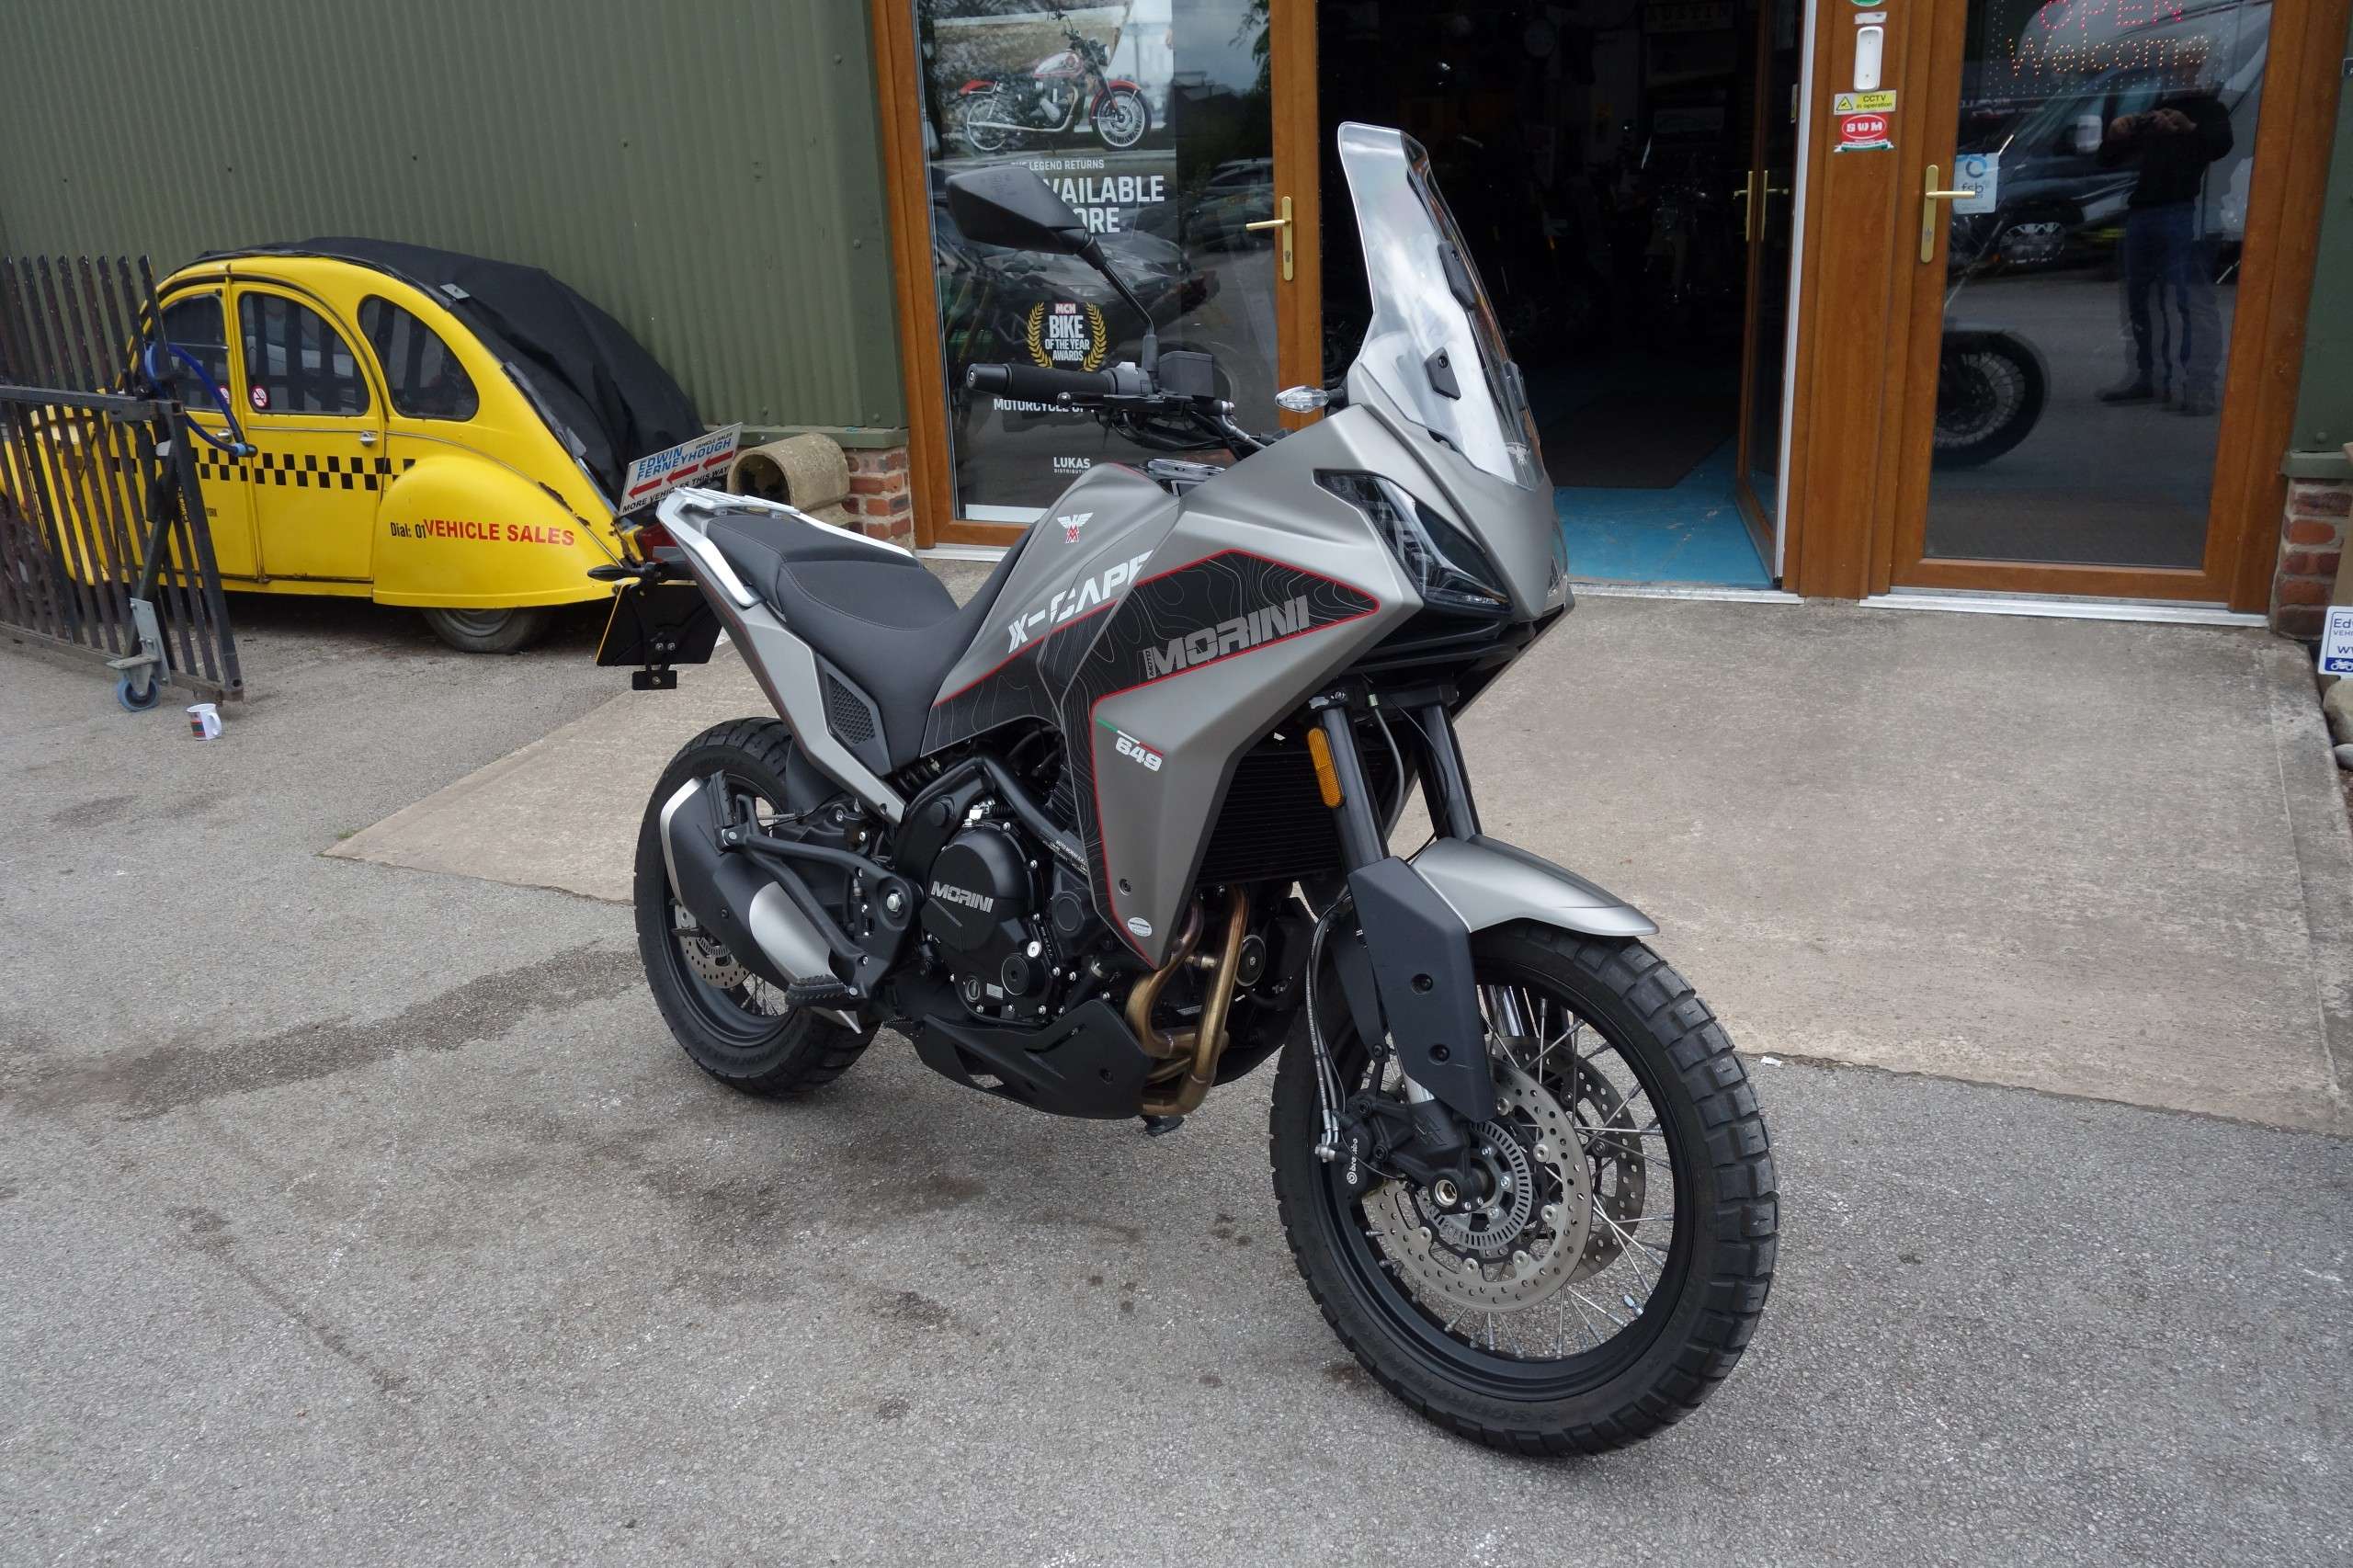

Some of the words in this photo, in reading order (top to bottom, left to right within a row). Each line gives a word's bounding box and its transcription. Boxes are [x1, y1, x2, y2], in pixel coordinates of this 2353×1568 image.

[2039, 0, 2183, 29] OPEN
[1862, 95, 1886, 103] CCTV
[1863, 100, 1893, 109] operation
[1029, 160, 1063, 171] LEGEND
[1064, 159, 1105, 170] RETURNS
[1043, 175, 1165, 204] VAILABLE
[1054, 303, 1076, 314] MCN
[1049, 314, 1085, 338] BIKE
[1044, 338, 1054, 350] OF
[1055, 338, 1070, 350] THE
[1070, 338, 1090, 350] YEAR
[1051, 350, 1085, 361] AWARDS
[636, 437, 732, 482] FERNEYHOUGH
[639, 447, 683, 472] EDWIN
[1053, 457, 1091, 469] LUKAS
[622, 497, 648, 513] MORE
[650, 481, 689, 502] VEHICES
[691, 473, 710, 485] THIS
[390, 521, 412, 538] Dial:
[423, 518, 501, 540] VEHICLE
[506, 524, 574, 546] SALES
[2334, 618, 2353, 629] Ed
[1147, 595, 1311, 677] MORINI
[1114, 736, 1163, 772] 649
[930, 881, 994, 914] MORINI
